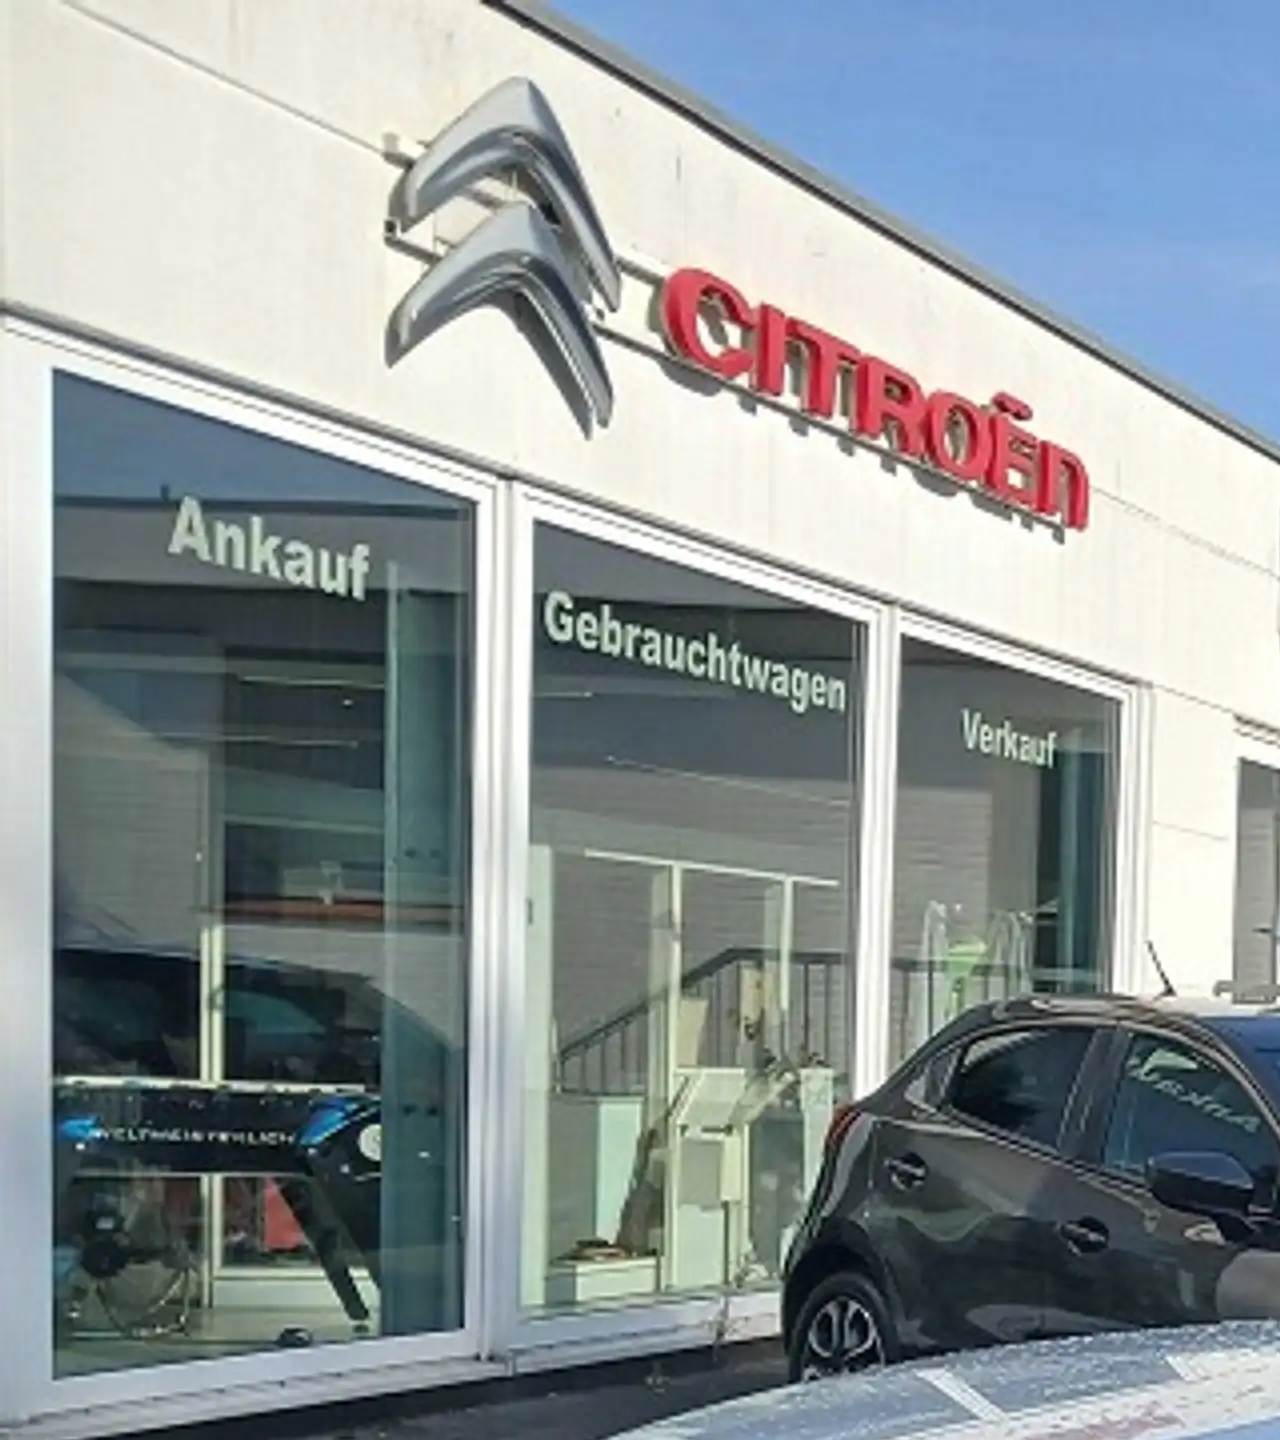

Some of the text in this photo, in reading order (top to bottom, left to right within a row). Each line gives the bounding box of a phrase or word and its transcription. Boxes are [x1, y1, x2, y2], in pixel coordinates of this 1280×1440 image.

[167, 495, 370, 601] Ankauf
[543, 591, 846, 713] Gebrauchtwagen
[961, 707, 1057, 769] Verkauf
